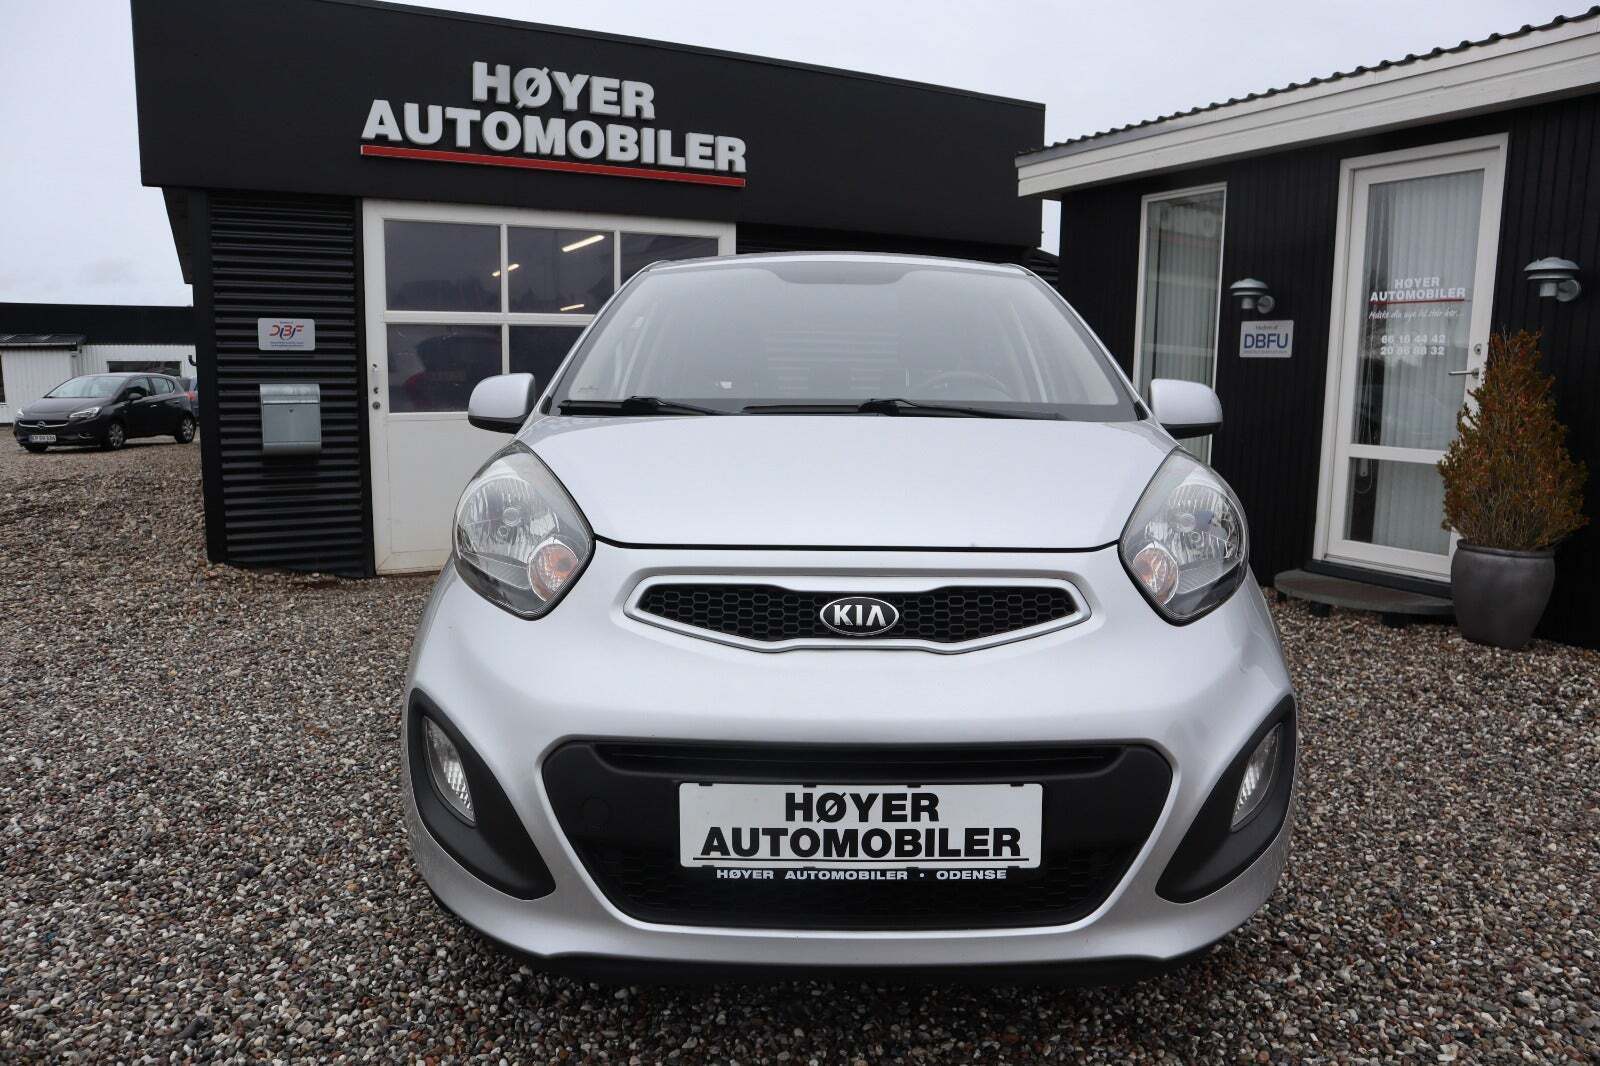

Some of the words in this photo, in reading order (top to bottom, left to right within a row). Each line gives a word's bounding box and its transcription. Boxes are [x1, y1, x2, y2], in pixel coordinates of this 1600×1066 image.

[472, 61, 655, 120] HØYER
[361, 99, 747, 173] AUTOMOBILER
[1370, 287, 1466, 301] AUTOMOBILER
[1244, 333, 1289, 349] DBFU
[1431, 334, 1446, 344] 42
[1380, 346, 1394, 356] 20
[1430, 345, 1445, 356] 32
[834, 604, 887, 627] KIA
[785, 792, 940, 824] HØYER
[700, 827, 1021, 859] AUTOMOBILER
[716, 869, 774, 881] HØYER
[784, 869, 908, 881] AUTOMOBILER
[936, 869, 1007, 881] ODENSE
